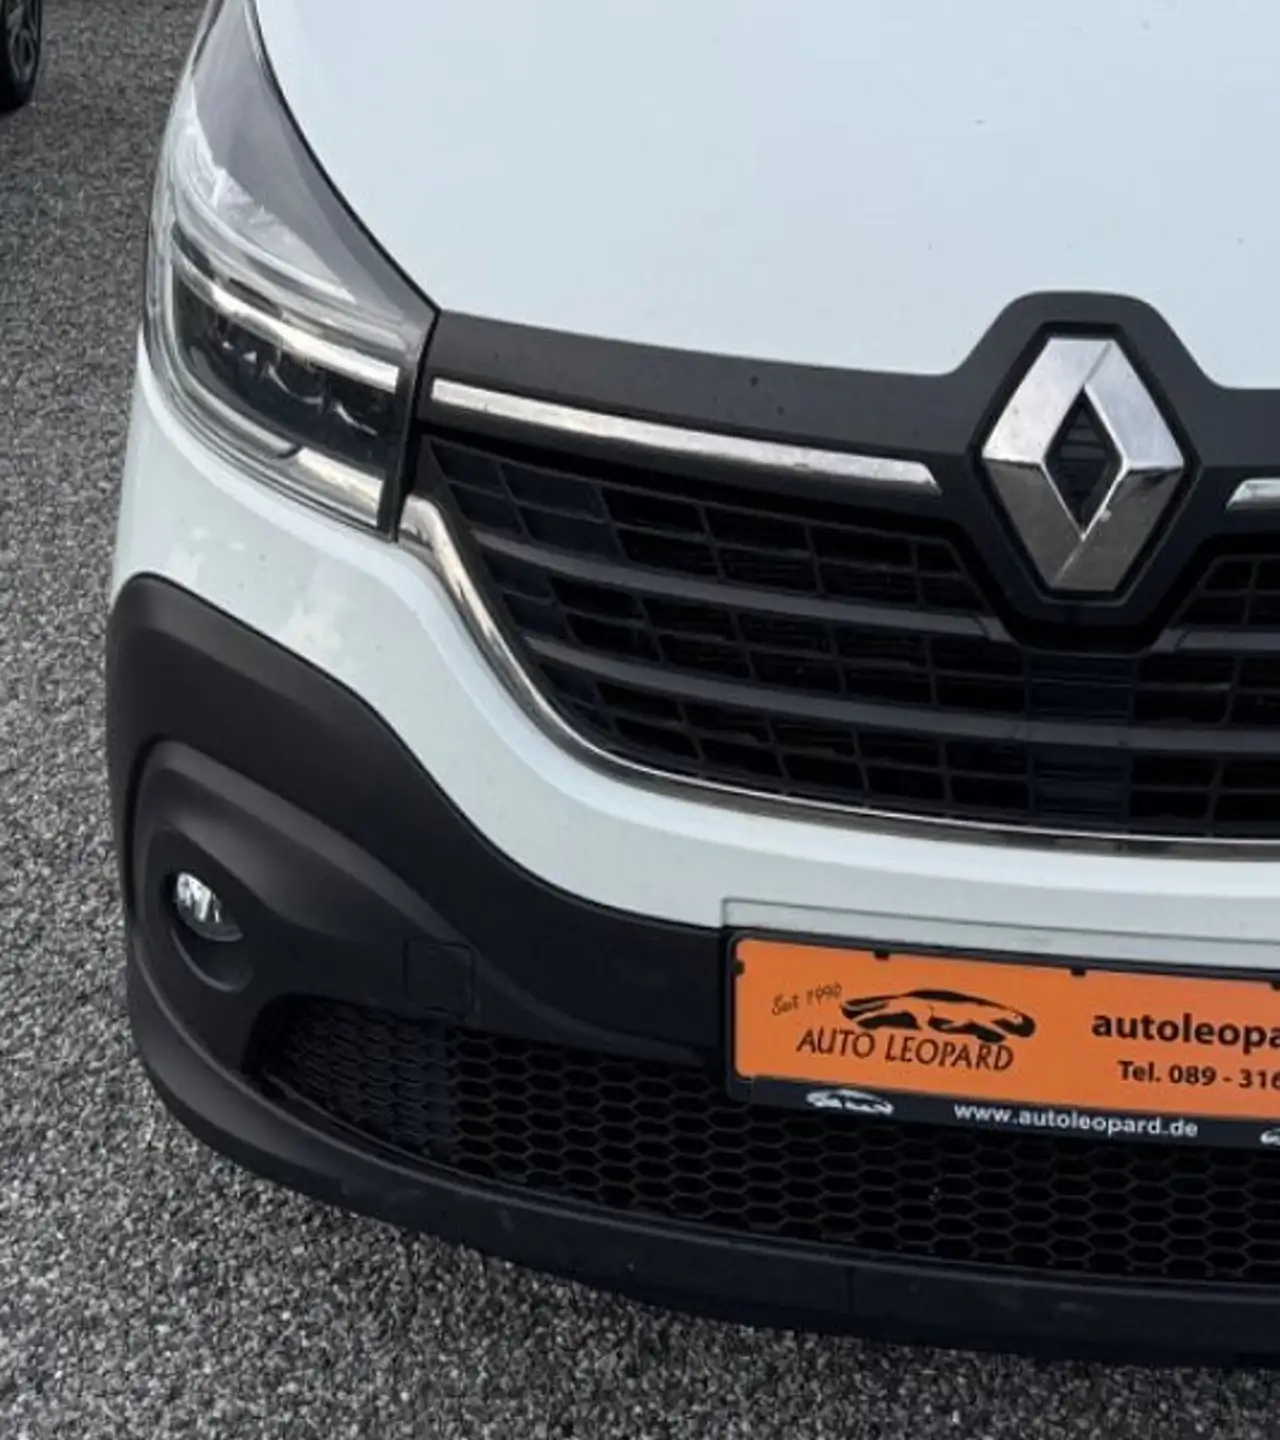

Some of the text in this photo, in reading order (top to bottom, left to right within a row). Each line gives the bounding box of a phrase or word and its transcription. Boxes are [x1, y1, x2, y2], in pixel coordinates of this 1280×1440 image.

[796, 1028, 1015, 1072] AUTO LEOPARD
[1118, 1059, 1162, 1083] Tel.
[1168, 1063, 1217, 1086] 089
[953, 1103, 1199, 1138] www.autoleopard.de
